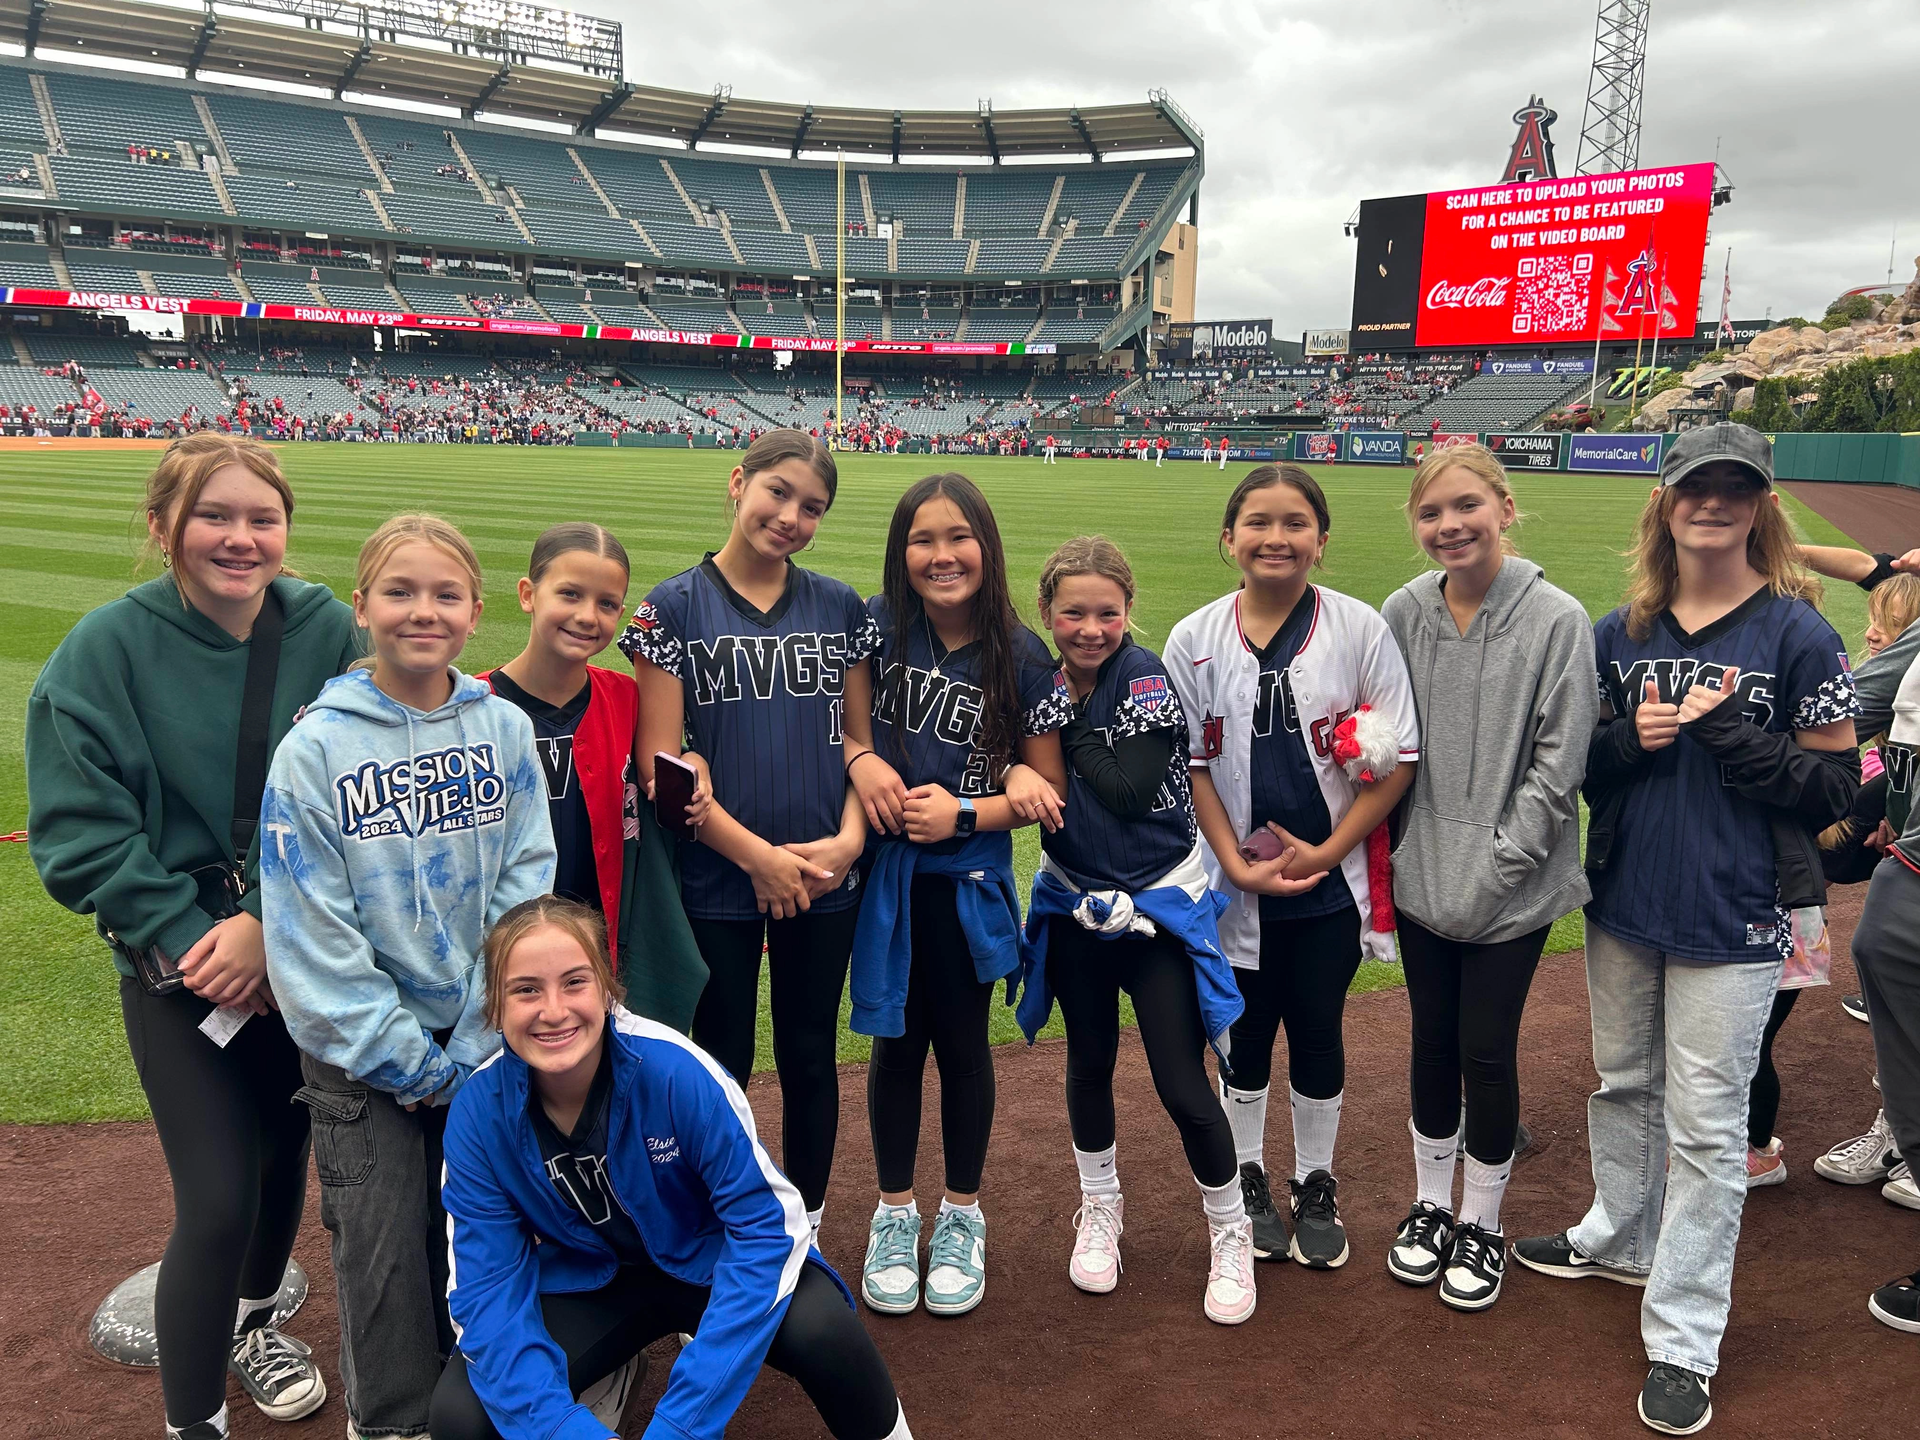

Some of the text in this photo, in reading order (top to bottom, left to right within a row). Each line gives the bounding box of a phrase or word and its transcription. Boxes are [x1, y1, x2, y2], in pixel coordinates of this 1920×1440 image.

[1446, 171, 1684, 211] SCAN HERE TO UPLOAD YOUR PHOTOS
[1462, 197, 1664, 230] FOR A CHANCE TO BE FEATURED
[1490, 224, 1626, 250] ON THE VIDEO BOARD
[1426, 275, 1512, 310] Coca-Cola
[67, 291, 192, 312] ANGELS VEST
[294, 308, 404, 326] FRIDAY, MAY 23RD
[420, 318, 480, 327] NITTO
[491, 322, 559, 333] angels.com/promotions
[1358, 322, 1411, 332] PROUD PARTNER
[631, 328, 713, 344] ANGELS VEST
[771, 338, 809, 350] FRIDAY,
[810, 340, 834, 350] MAY
[1214, 325, 1266, 347] Modelo
[1311, 334, 1344, 349] Modelo
[1364, 440, 1400, 452] VANDA
[1504, 438, 1552, 450] YOKOHAMA
[1528, 455, 1552, 466] TIRES
[1574, 447, 1638, 460] MemorialCare
[688, 632, 848, 706] MVGS
[1132, 678, 1165, 695] USA
[872, 657, 986, 749] MVG
[1134, 690, 1166, 701] SOFTBALL
[343, 747, 493, 832] MISSION
[396, 775, 500, 837] VIEJO
[361, 808, 502, 838] 2024 ALL STARS
[647, 1136, 676, 1151] Elsie
[651, 1146, 680, 1164] 2024
